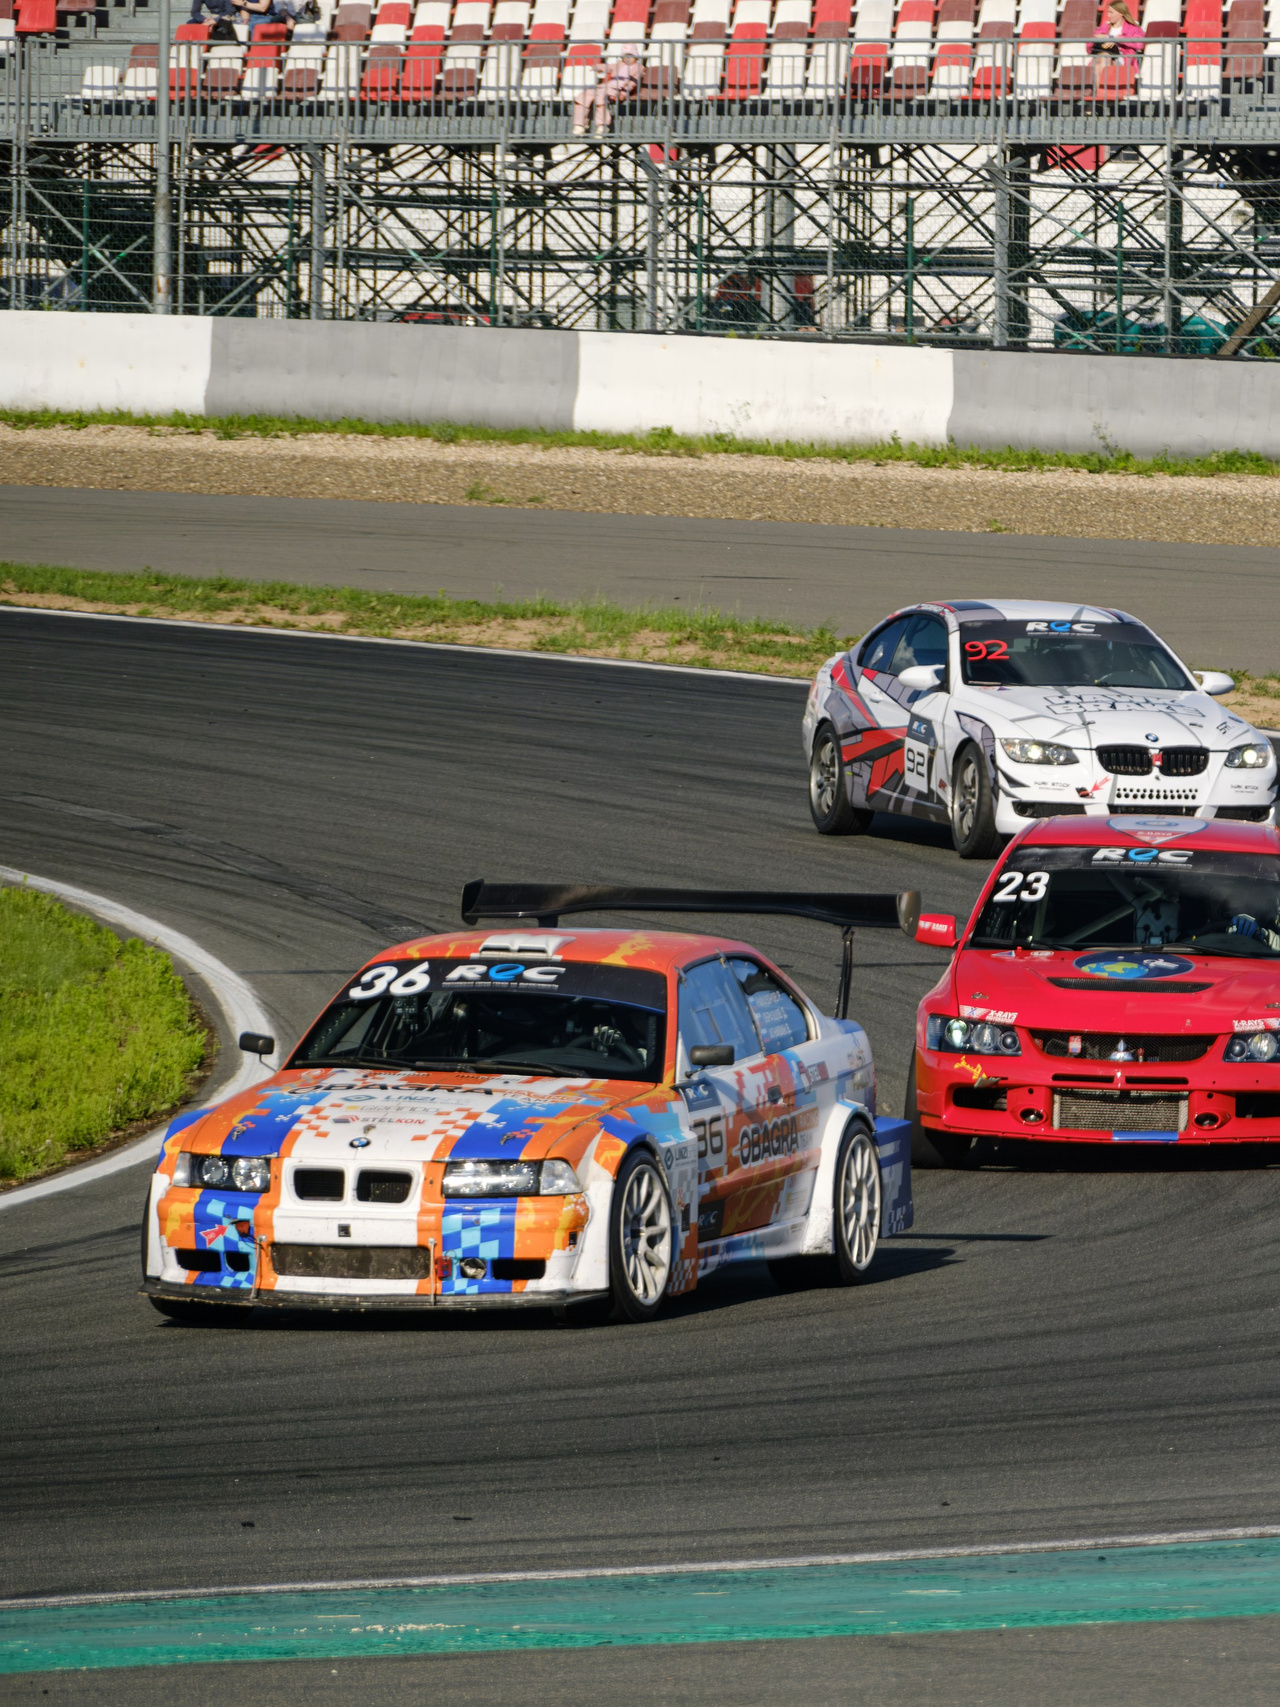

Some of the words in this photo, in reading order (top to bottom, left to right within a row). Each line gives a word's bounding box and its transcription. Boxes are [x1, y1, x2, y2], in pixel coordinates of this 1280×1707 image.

[965, 640, 1010, 661] 92
[1043, 694, 1185, 706] HAWK
[906, 747, 926, 777] 92
[993, 872, 1050, 903] 23
[349, 961, 430, 1000] 36
[988, 1009, 1018, 1019] X-RAYS
[287, 1083, 493, 1095] OBAGRA
[361, 1116, 426, 1125] STELKON
[693, 1115, 723, 1158] 36
[739, 1114, 800, 1167] OBAGRA
